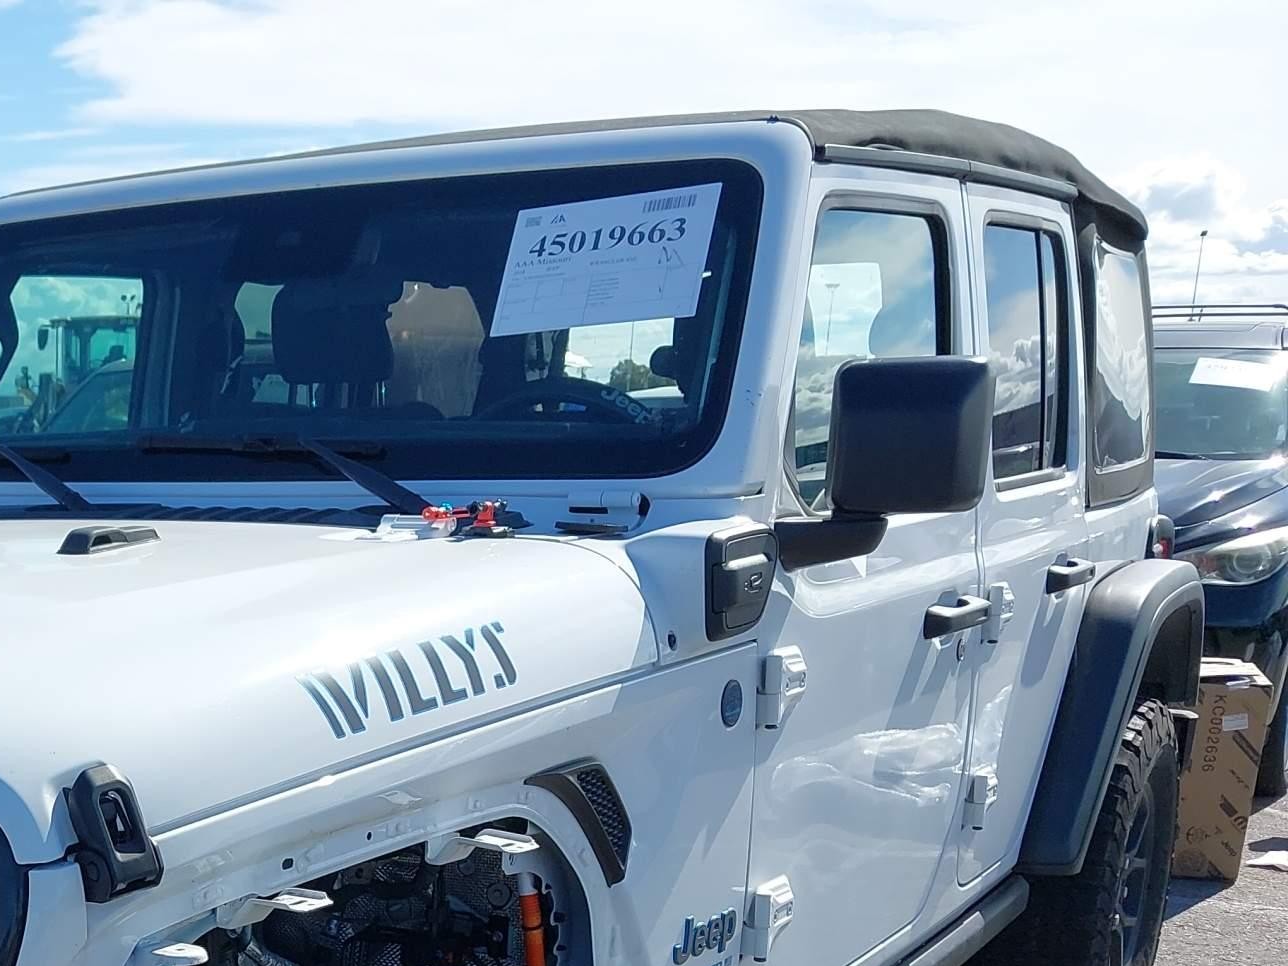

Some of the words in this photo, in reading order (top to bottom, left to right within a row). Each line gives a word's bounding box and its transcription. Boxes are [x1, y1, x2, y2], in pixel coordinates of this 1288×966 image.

[529, 217, 687, 258] 45019663
[295, 622, 517, 740] WILLYS
[1201, 694, 1228, 773] KC002636
[673, 907, 737, 966] Jeep
